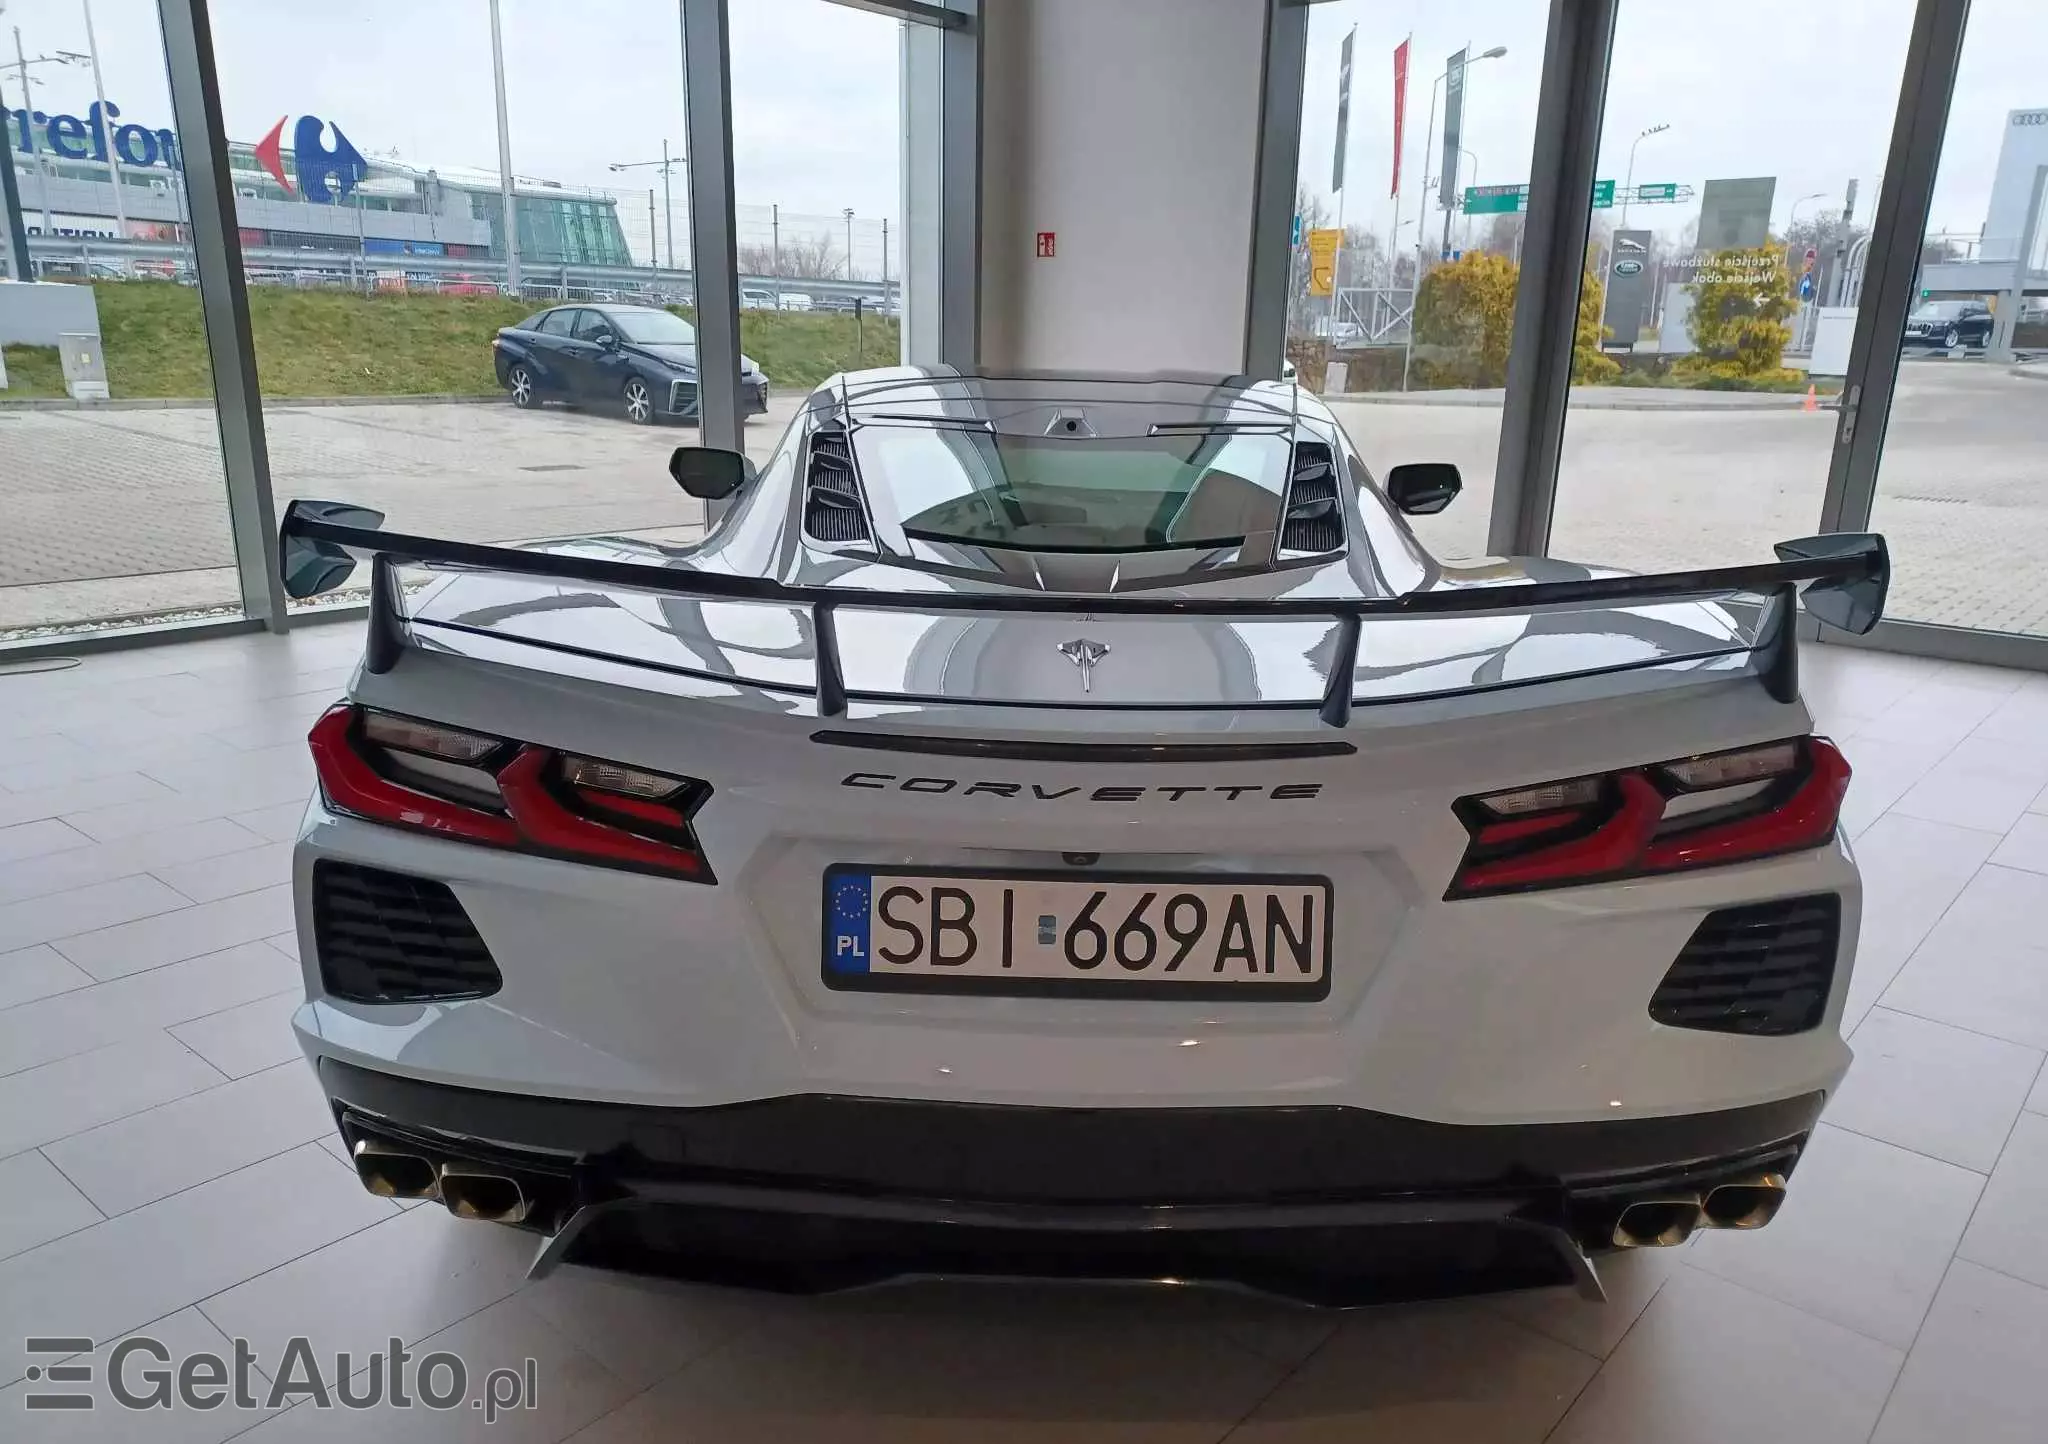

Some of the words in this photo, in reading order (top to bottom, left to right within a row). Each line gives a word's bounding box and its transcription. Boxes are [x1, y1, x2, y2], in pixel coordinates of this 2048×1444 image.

[840, 772, 1324, 802] CORVETTE
[877, 885, 1015, 969] SBI
[1063, 890, 1315, 975] 669AN
[836, 934, 866, 958] PL
